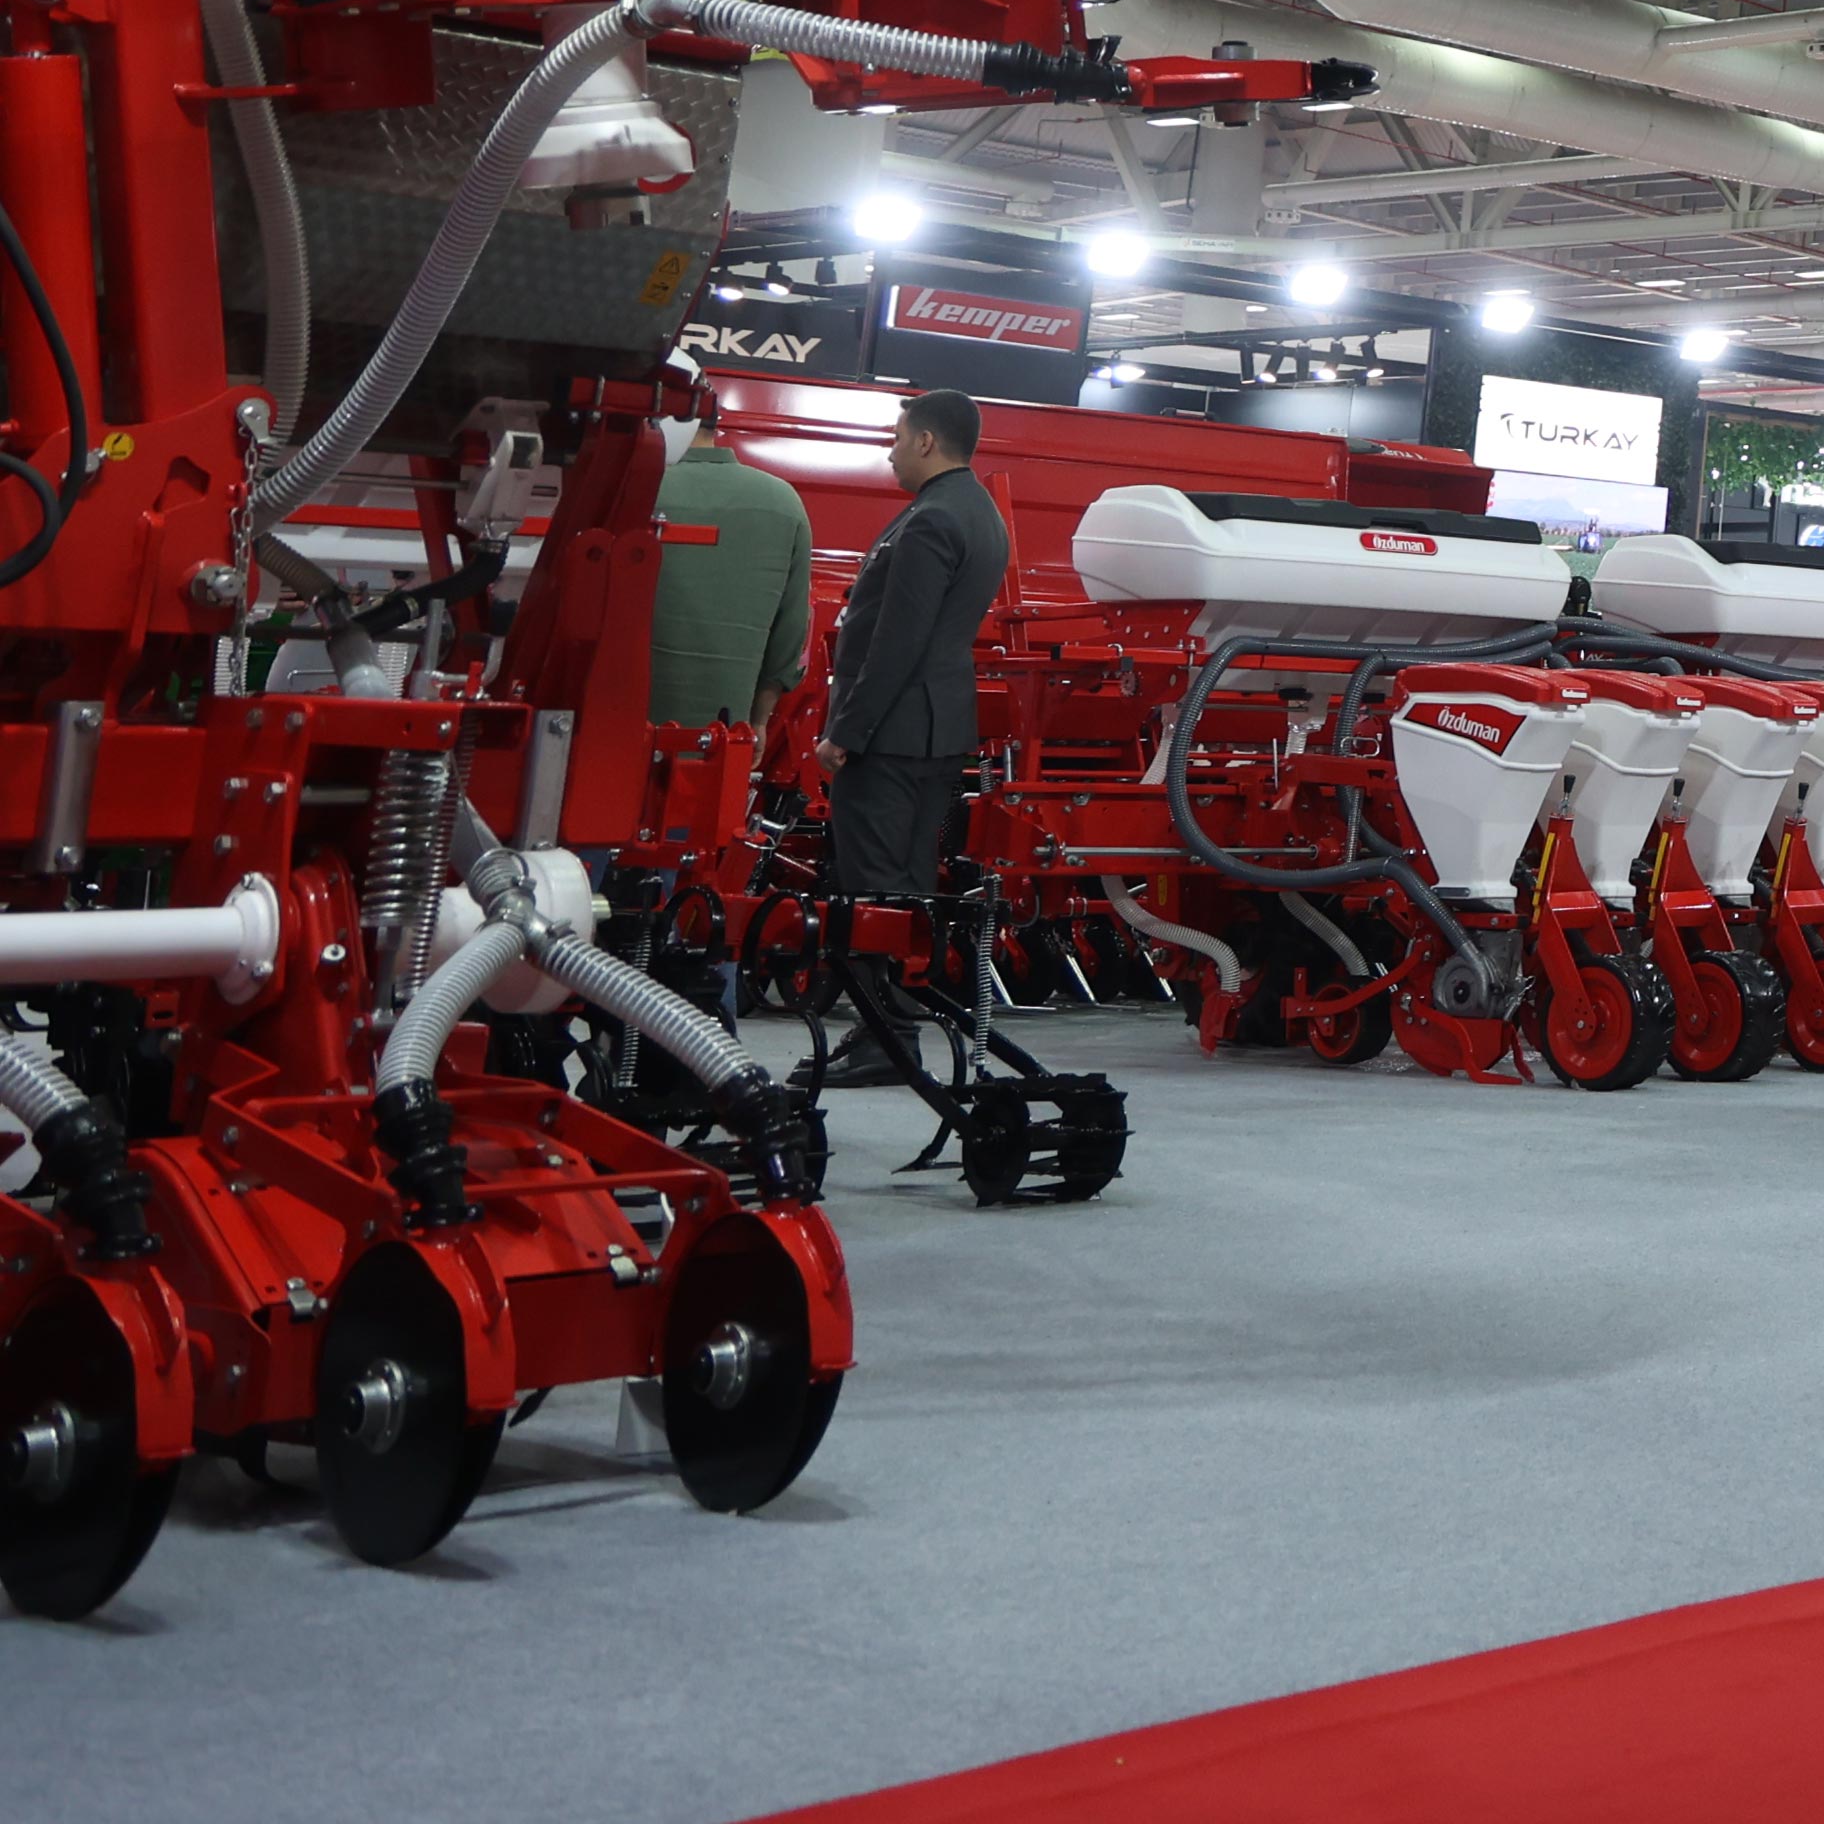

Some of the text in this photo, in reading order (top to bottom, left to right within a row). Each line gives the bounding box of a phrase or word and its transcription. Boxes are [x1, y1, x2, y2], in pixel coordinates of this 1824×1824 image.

[907, 288, 1071, 340] kemper
[681, 323, 822, 363] RKAY
[1521, 420, 1639, 451] TURKAY
[1373, 532, 1425, 553] Özduman
[1438, 706, 1500, 743] Özduman
